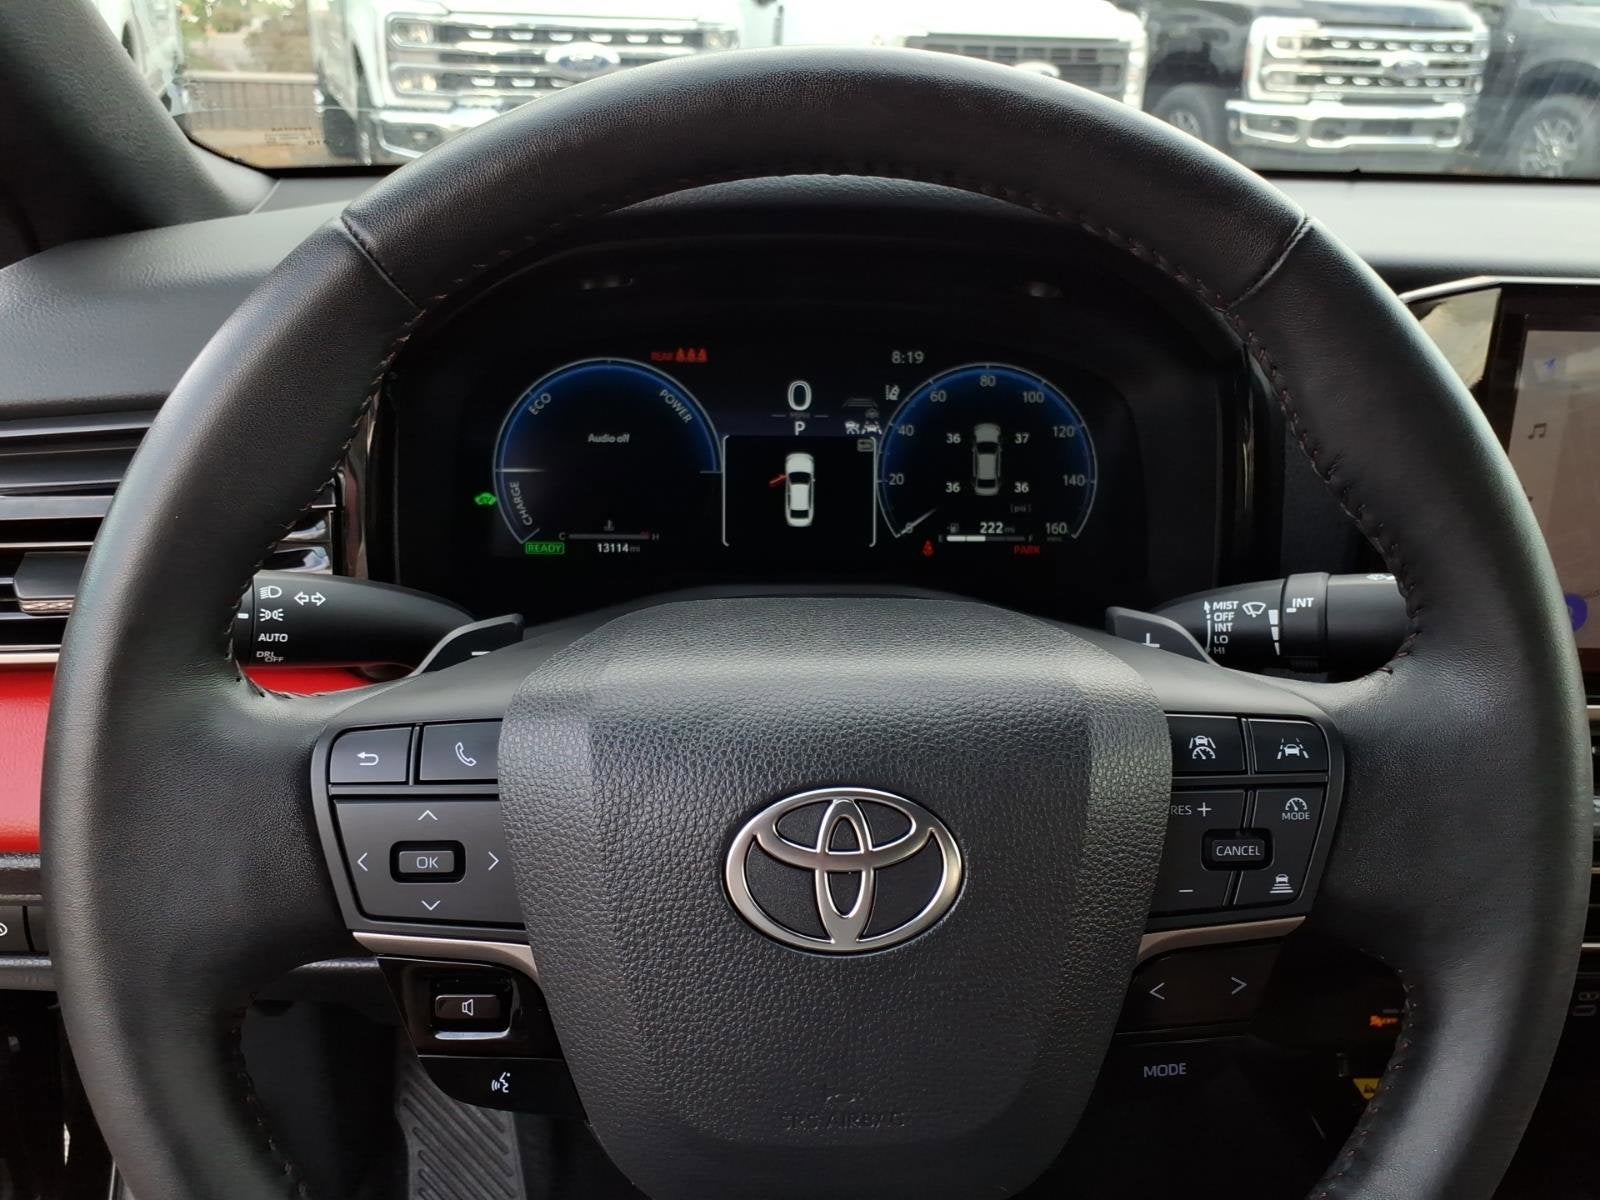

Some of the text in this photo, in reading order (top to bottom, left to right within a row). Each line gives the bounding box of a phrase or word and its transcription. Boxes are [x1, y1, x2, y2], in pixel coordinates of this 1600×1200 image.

[892, 351, 924, 364] 8:19
[979, 375, 996, 387] 80
[787, 380, 812, 411] 0
[930, 390, 946, 403] 60
[1022, 391, 1045, 403] 100
[528, 392, 552, 415] ECO
[659, 389, 693, 424] POWER
[795, 421, 806, 436] P
[898, 425, 914, 436] 40
[1053, 426, 1075, 438] 120
[587, 433, 630, 444] Audio off
[946, 433, 961, 444] 36
[1014, 433, 1029, 444] 37
[889, 473, 904, 486] 20
[1063, 475, 1085, 487] 140
[945, 482, 960, 493] 36
[1014, 482, 1029, 493] 36
[509, 481, 533, 526] CHARGE
[979, 521, 1004, 534] 222
[1045, 522, 1067, 534] 160
[527, 543, 563, 553] READY
[597, 543, 629, 553] 13114
[1212, 600, 1239, 610] MIST
[1292, 597, 1314, 608] INT
[1213, 611, 1235, 621] OFF
[1214, 622, 1234, 632] INT
[258, 633, 288, 643] AUTO
[1214, 635, 1229, 644] LO
[1213, 646, 1226, 654] HI
[1170, 805, 1192, 816] RES
[1281, 812, 1310, 820] MODE
[1216, 845, 1261, 857] CANCEL
[416, 856, 439, 869] OK
[1143, 1062, 1187, 1078] MODE
